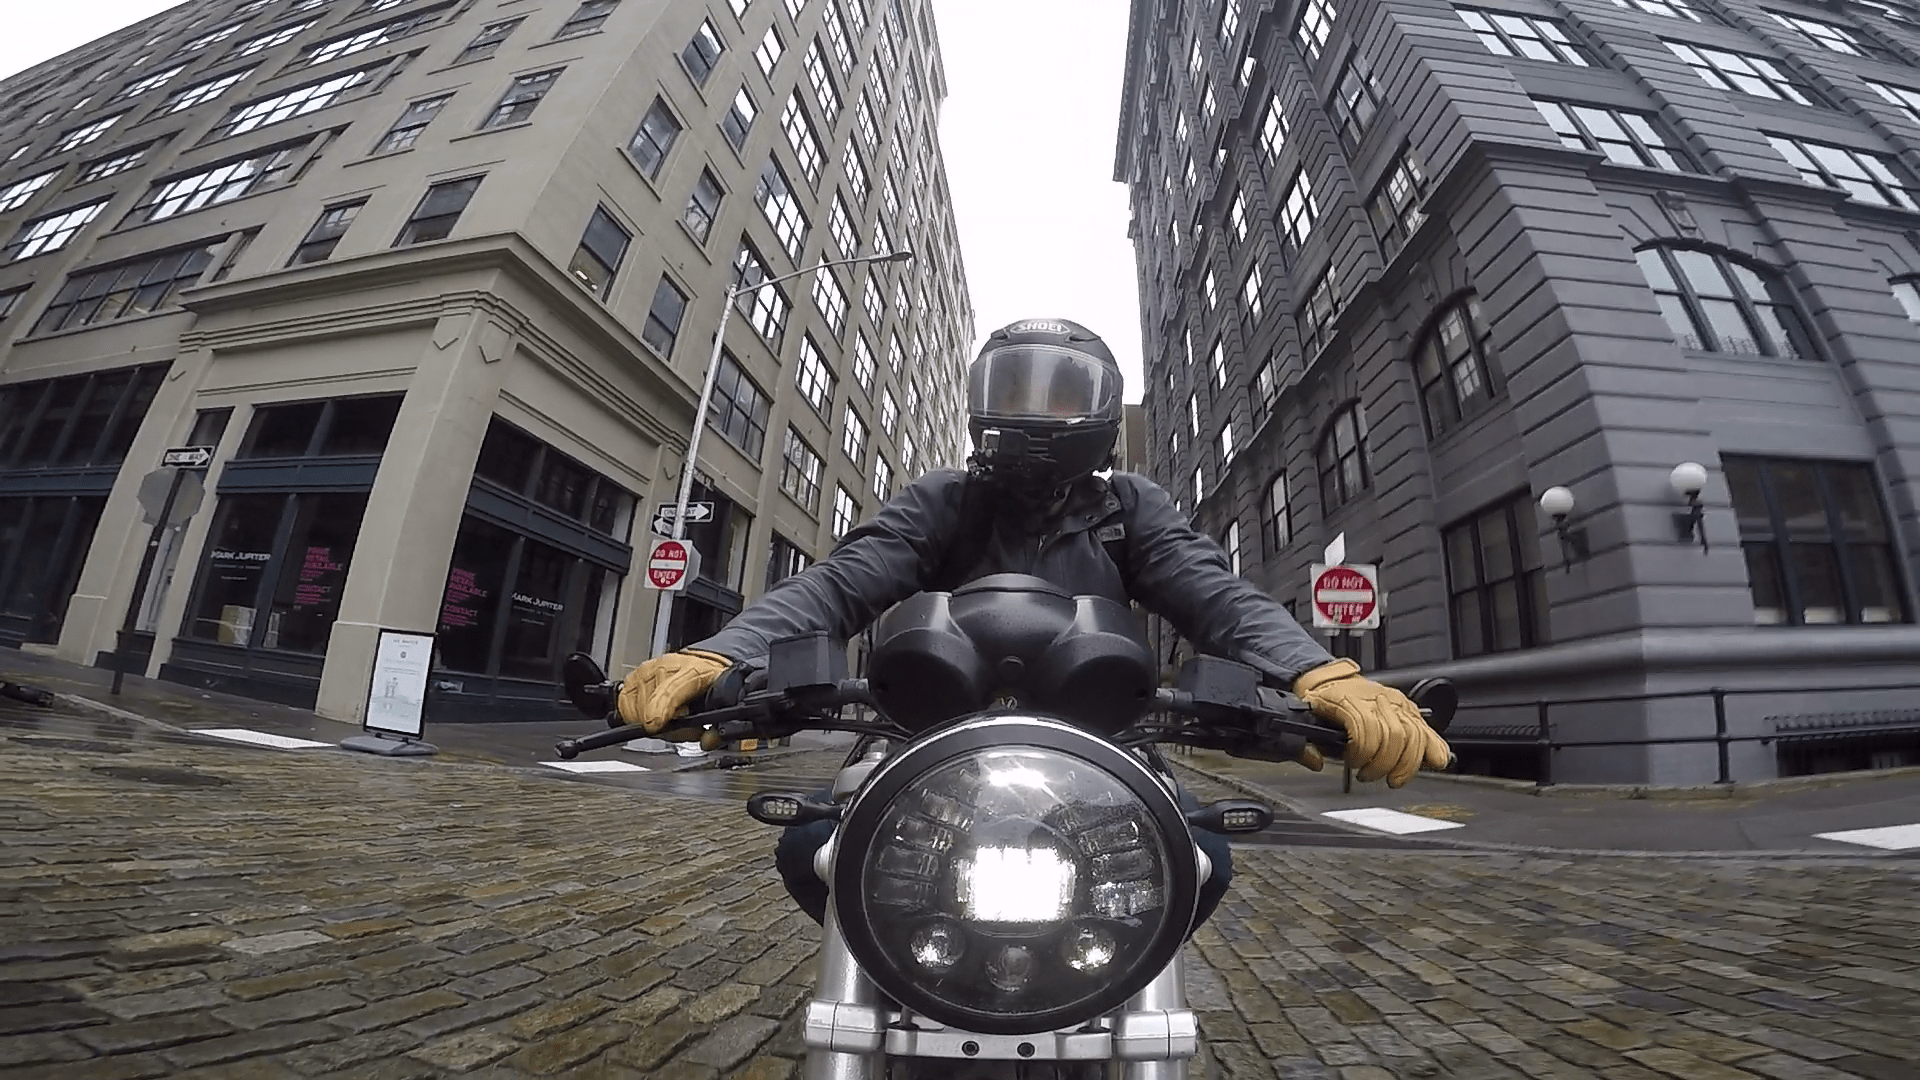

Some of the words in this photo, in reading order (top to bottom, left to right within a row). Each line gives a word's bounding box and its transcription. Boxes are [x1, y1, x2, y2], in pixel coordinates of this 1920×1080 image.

[1017, 322, 1062, 333] SHOEI
[210, 550, 235, 559] MARK
[235, 552, 271, 561] JUPITER
[655, 549, 666, 558] DO
[668, 549, 684, 559] NOT
[653, 569, 677, 580] ENTER
[1323, 576, 1339, 589] DO
[1342, 576, 1363, 589] NOT
[533, 597, 564, 611] JUPITER
[1327, 603, 1363, 616] ENTER
